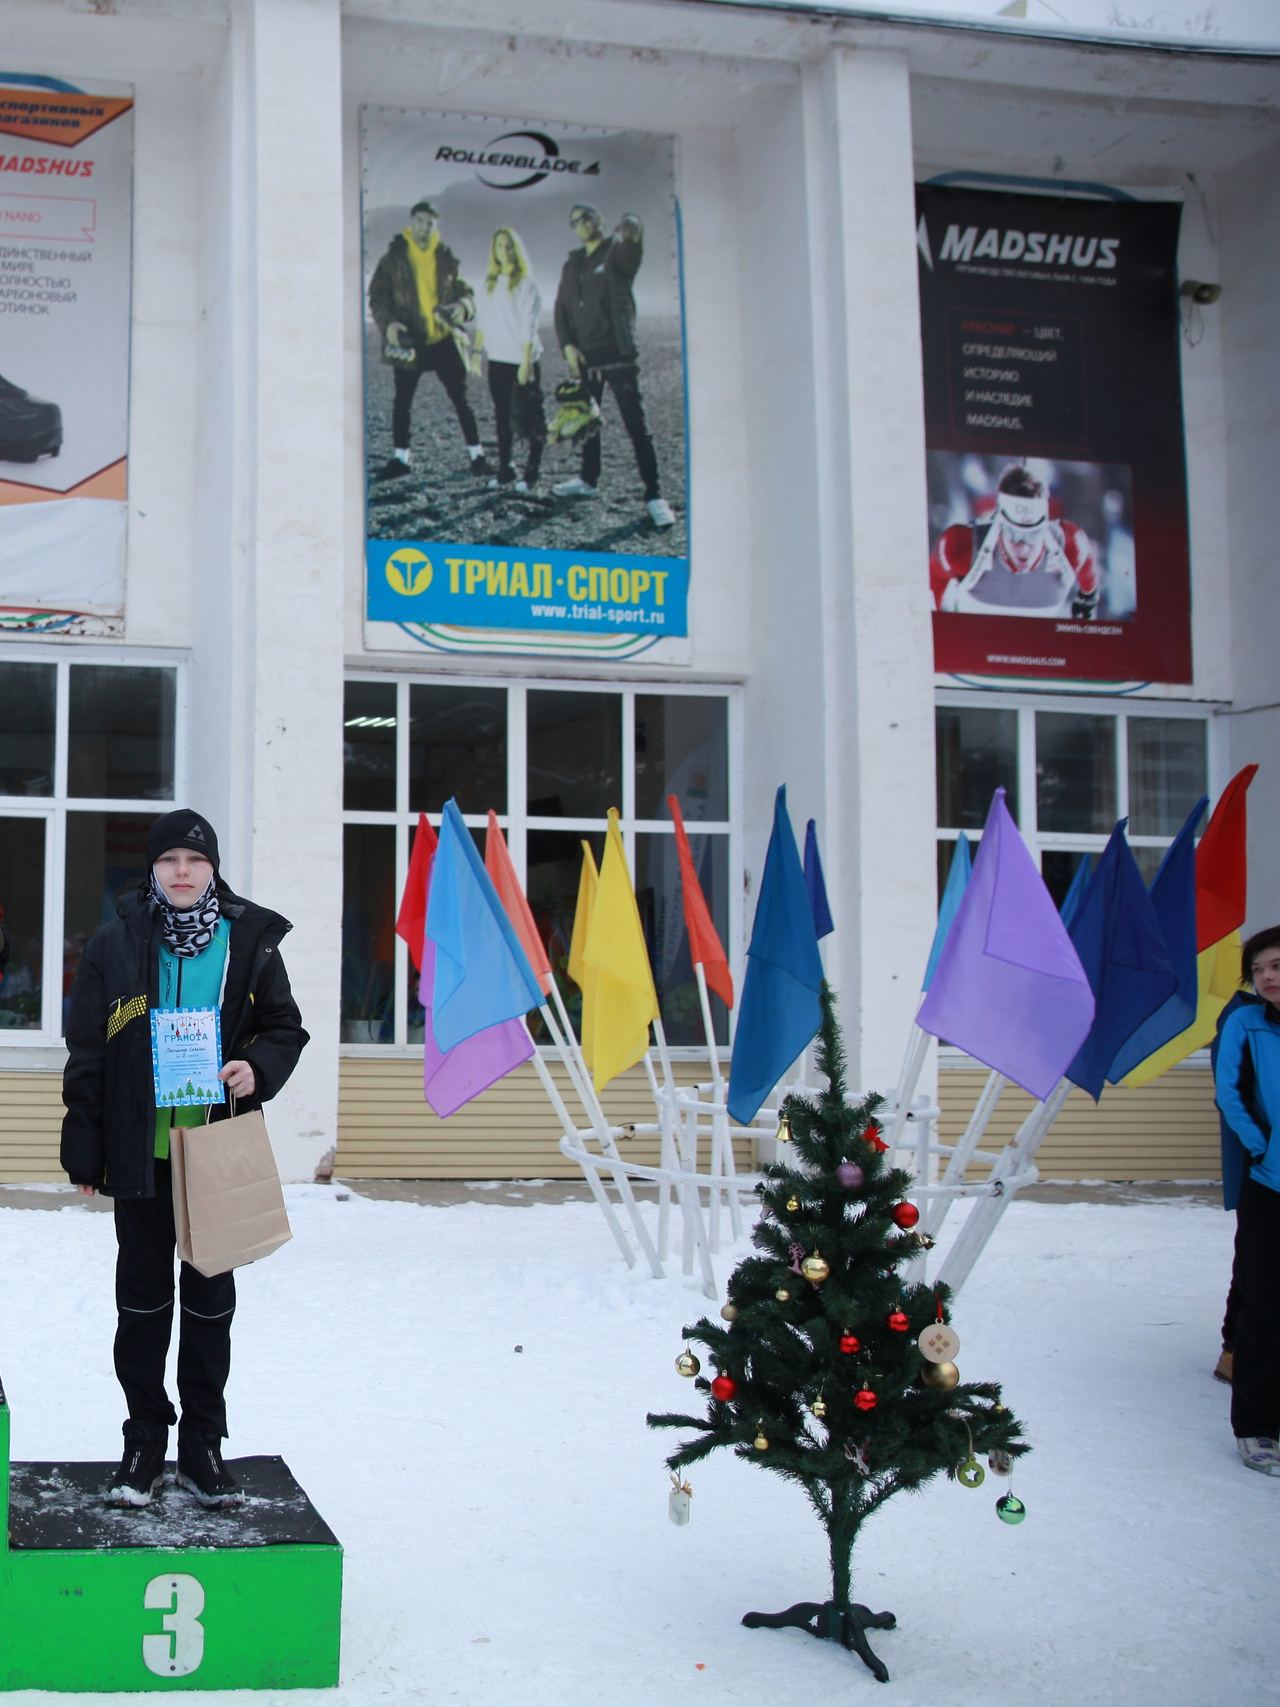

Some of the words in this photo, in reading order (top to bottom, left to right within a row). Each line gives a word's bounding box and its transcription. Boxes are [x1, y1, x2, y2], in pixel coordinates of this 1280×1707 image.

[0, 100, 105, 118] спортивных
[435, 145, 582, 173] ROLLERBLADE
[5, 209, 43, 224] NANO
[938, 223, 1121, 270] MADSHUS
[1, 261, 36, 274] МИРЕ
[530, 604, 666, 625] www.trial-sport.ru
[164, 1033, 208, 1043] ГРАМОТА
[142, 1573, 205, 1677] 3
